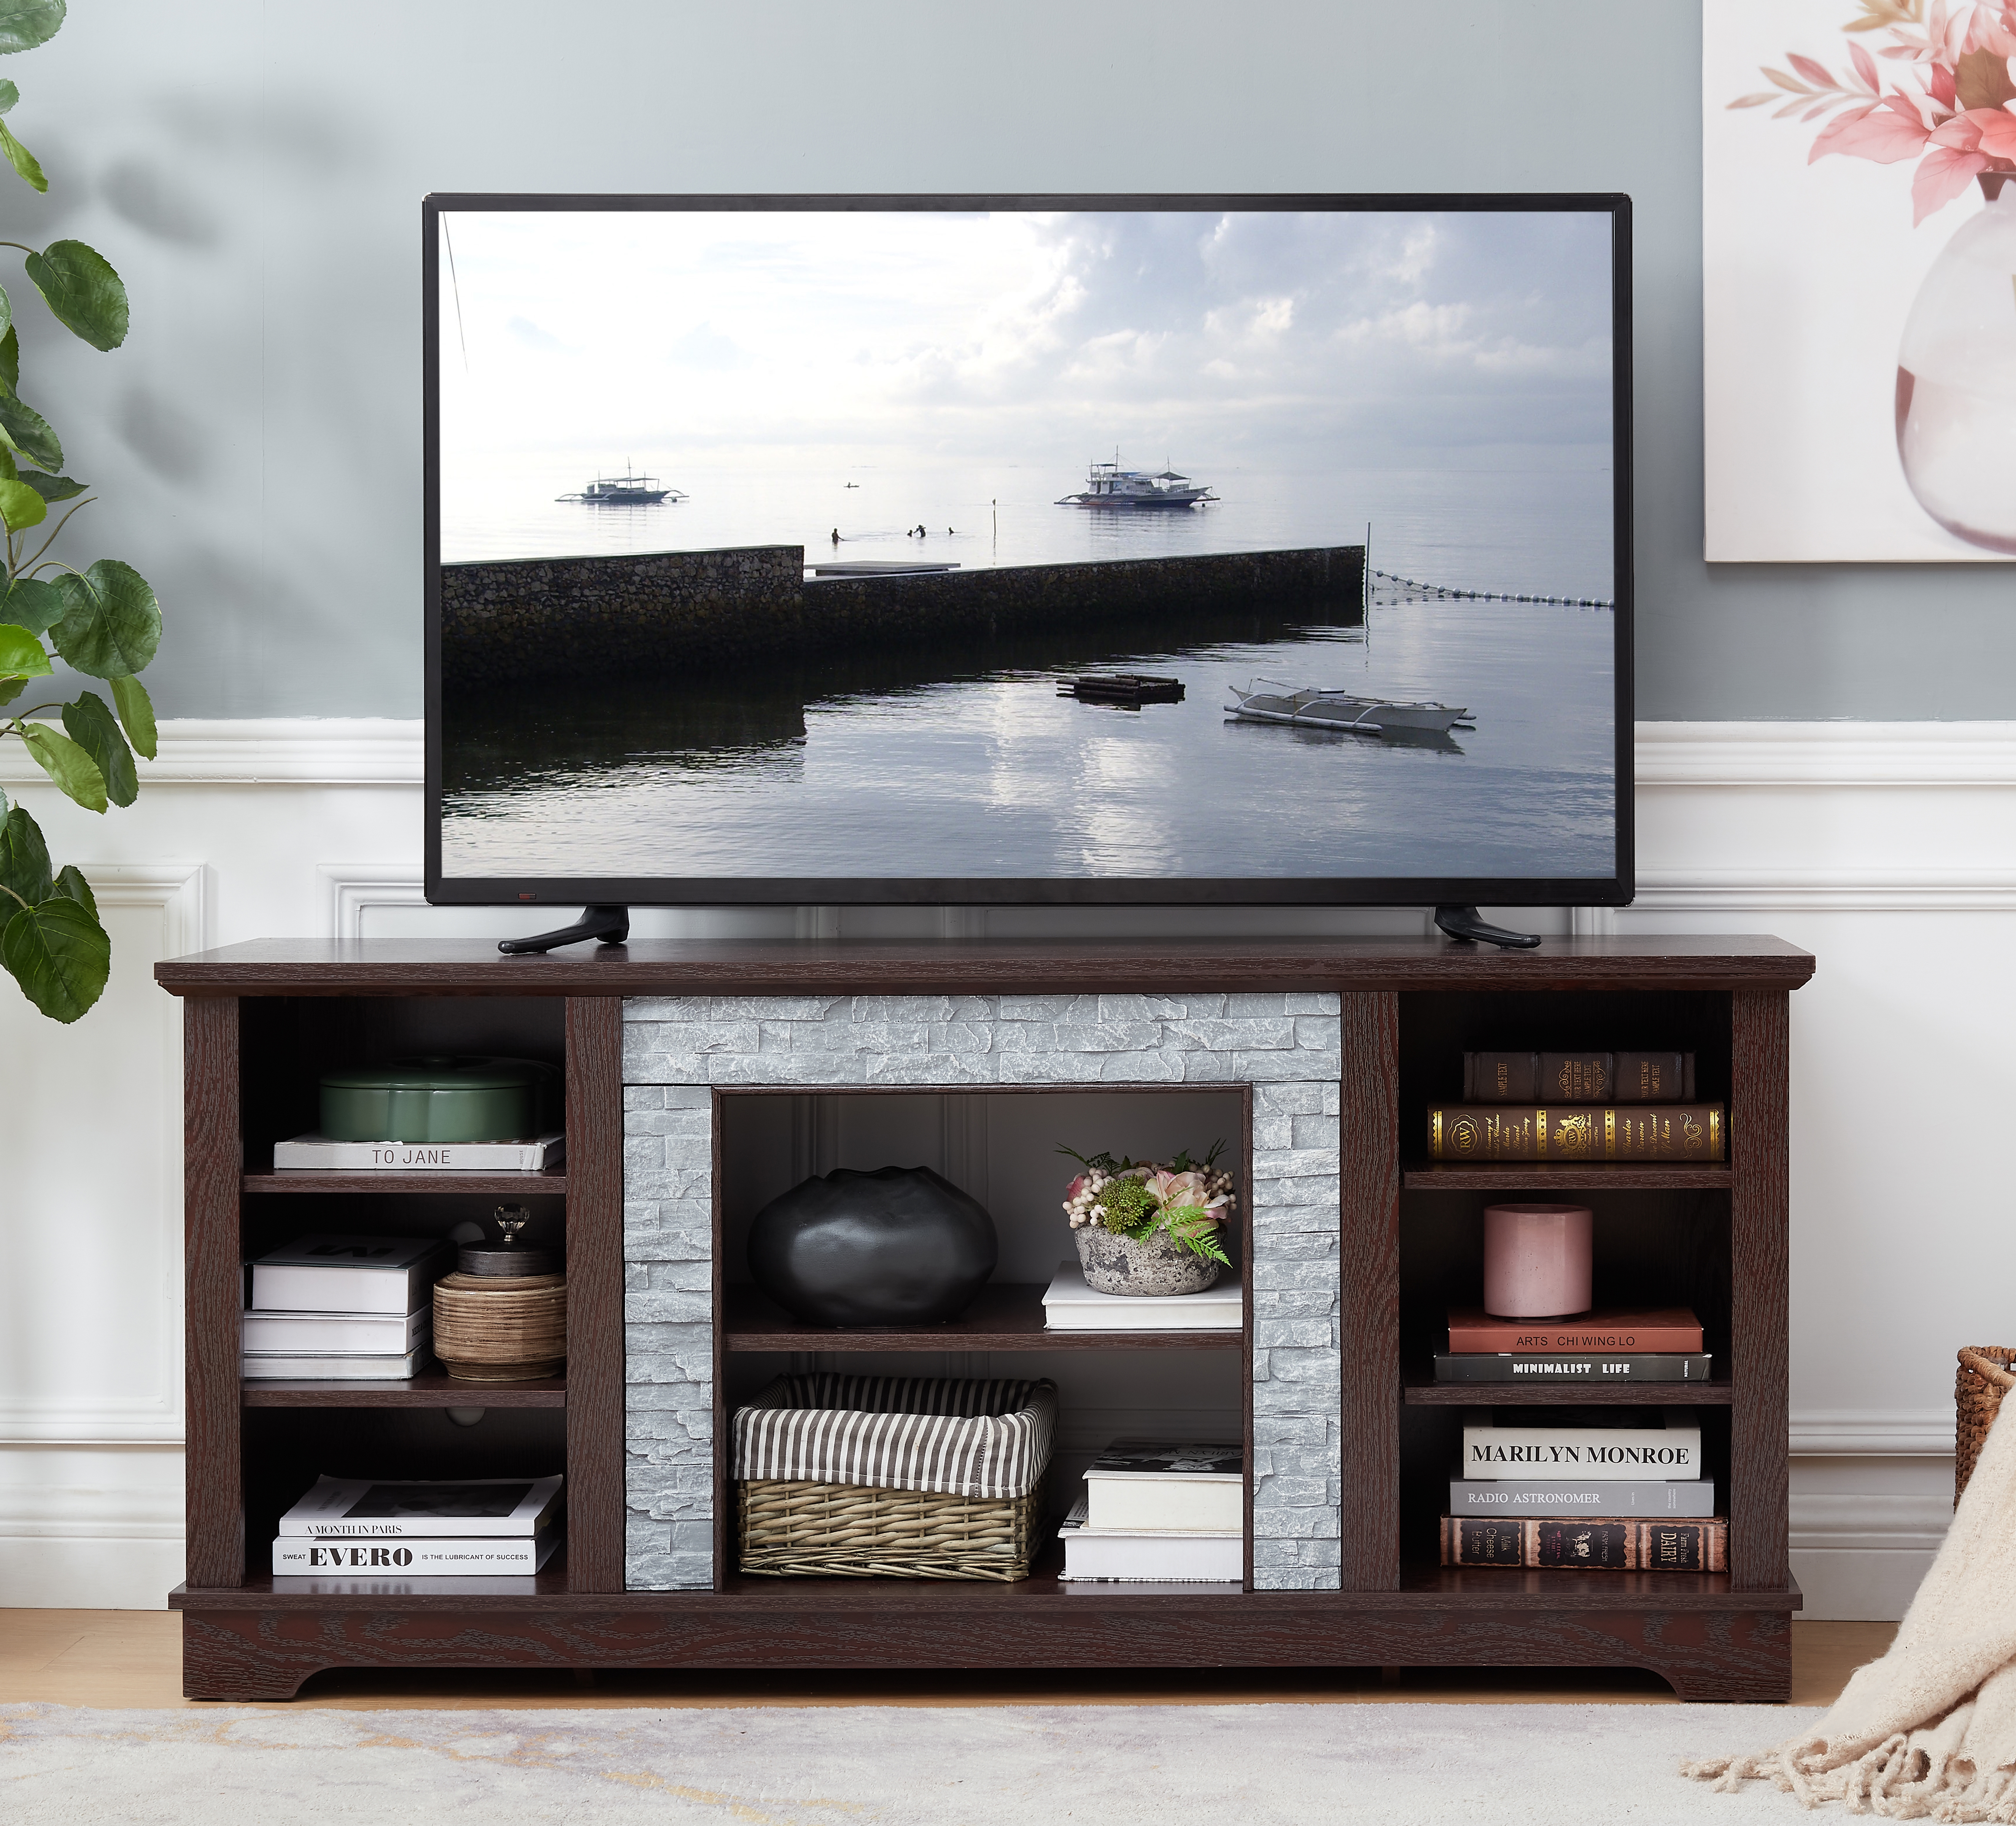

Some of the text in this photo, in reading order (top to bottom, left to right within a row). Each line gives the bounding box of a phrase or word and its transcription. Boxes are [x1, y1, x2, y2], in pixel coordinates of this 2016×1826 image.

[1498, 1063, 1507, 1096] SAMPLE TEXT
[1522, 1117, 1531, 1137] Zweig
[1622, 1118, 1632, 1154] Charles
[1661, 1118, 1670, 1143] Man
[1460, 1127, 1471, 1148] RW
[1486, 1125, 1494, 1152] Treasury
[1569, 1130, 1576, 1145] RW
[372, 1150, 451, 1164] TO JANE
[1516, 1336, 1635, 1346] ARTS CHI WING LO
[1513, 1363, 1630, 1373] MINIMALIST LIFE
[1471, 1445, 1689, 1464] MARILYN MONROE
[1468, 1493, 1601, 1503] RADIO ASTRONOMER
[305, 1525, 402, 1534] A MONTH IN PARIS
[1472, 1531, 1482, 1555] Butter
[1486, 1528, 1497, 1558] Cheese
[1501, 1536, 1511, 1551] Milk
[1661, 1532, 1677, 1563] DAIRY
[1681, 1533, 1690, 1564] Farm Fresh
[308, 1548, 413, 1567] EVERO
